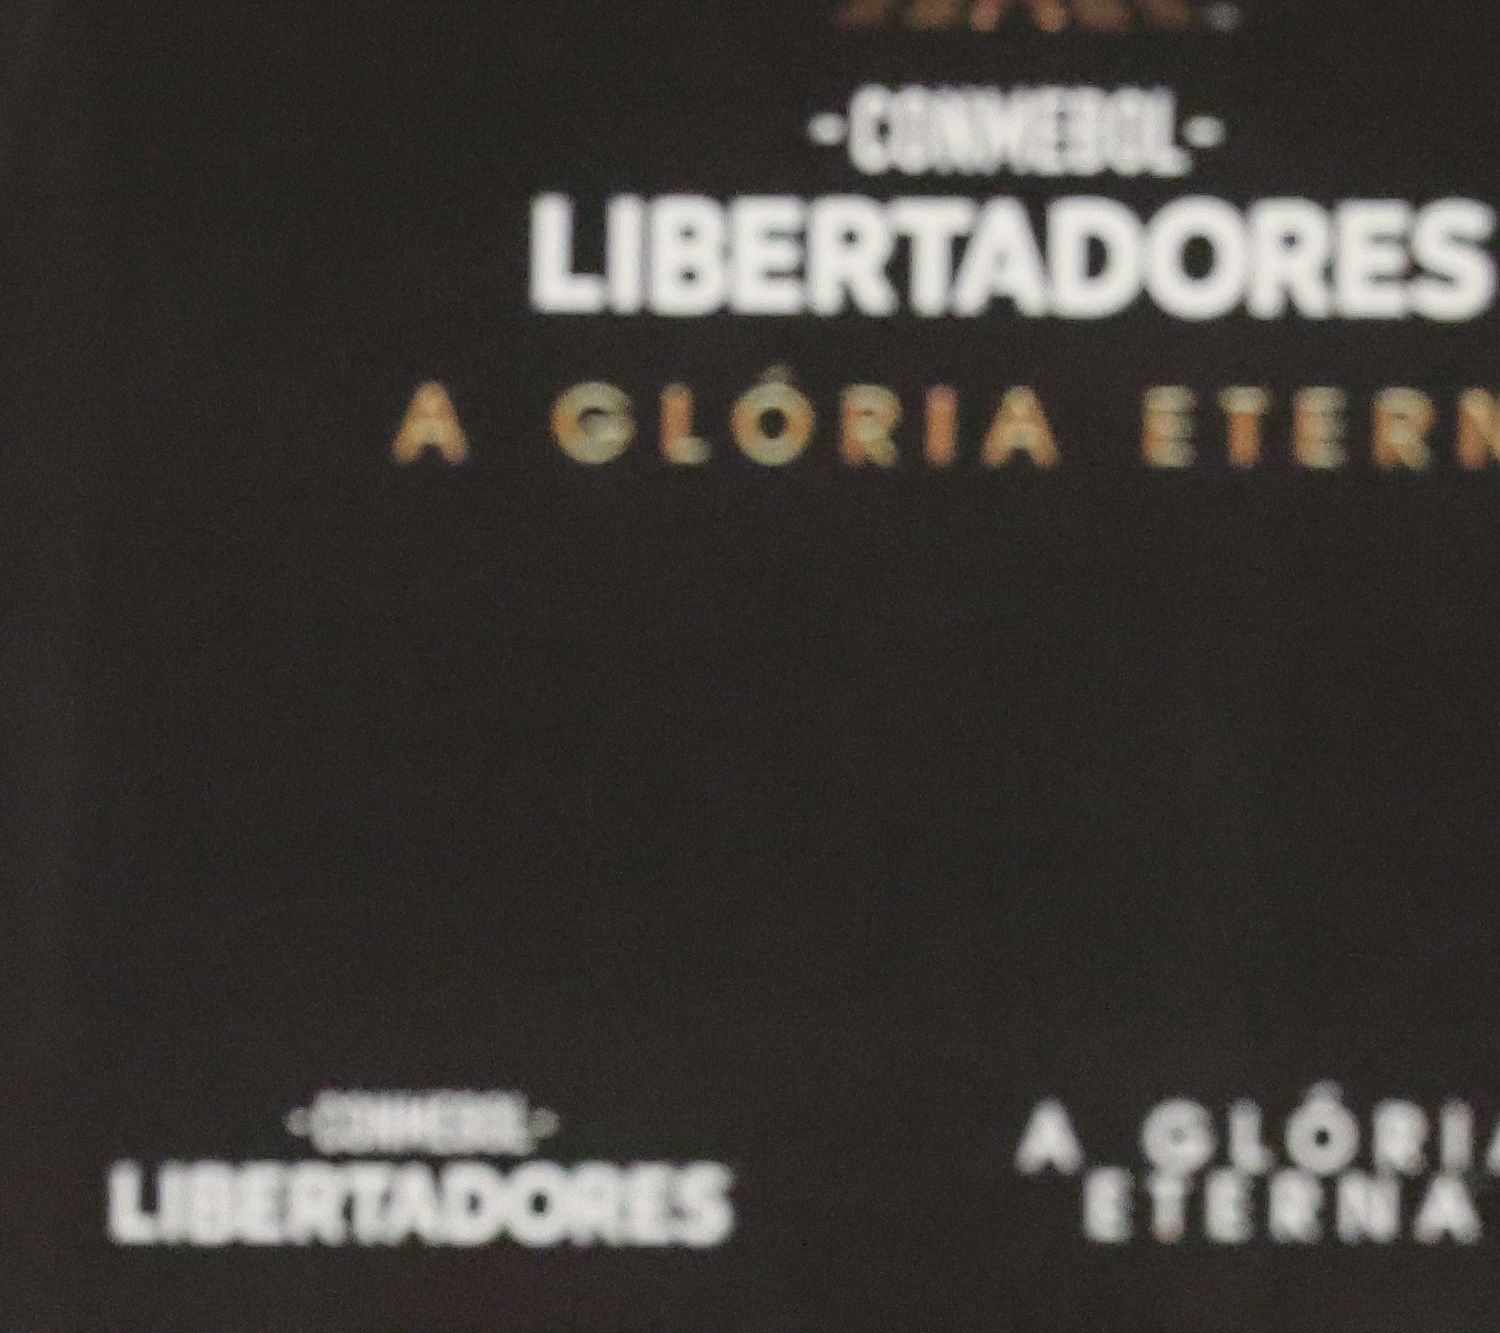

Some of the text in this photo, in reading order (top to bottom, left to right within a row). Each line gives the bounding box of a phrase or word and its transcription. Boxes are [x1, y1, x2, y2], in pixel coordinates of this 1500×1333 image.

[530, 194, 1496, 321] LIBERTADORES
[394, 382, 467, 462] A
[552, 367, 1057, 466] GLÓRIA
[1018, 1102, 1081, 1172] A
[109, 1161, 733, 1247] LIBERTADORES
[1082, 1176, 1480, 1243] ETERNA
